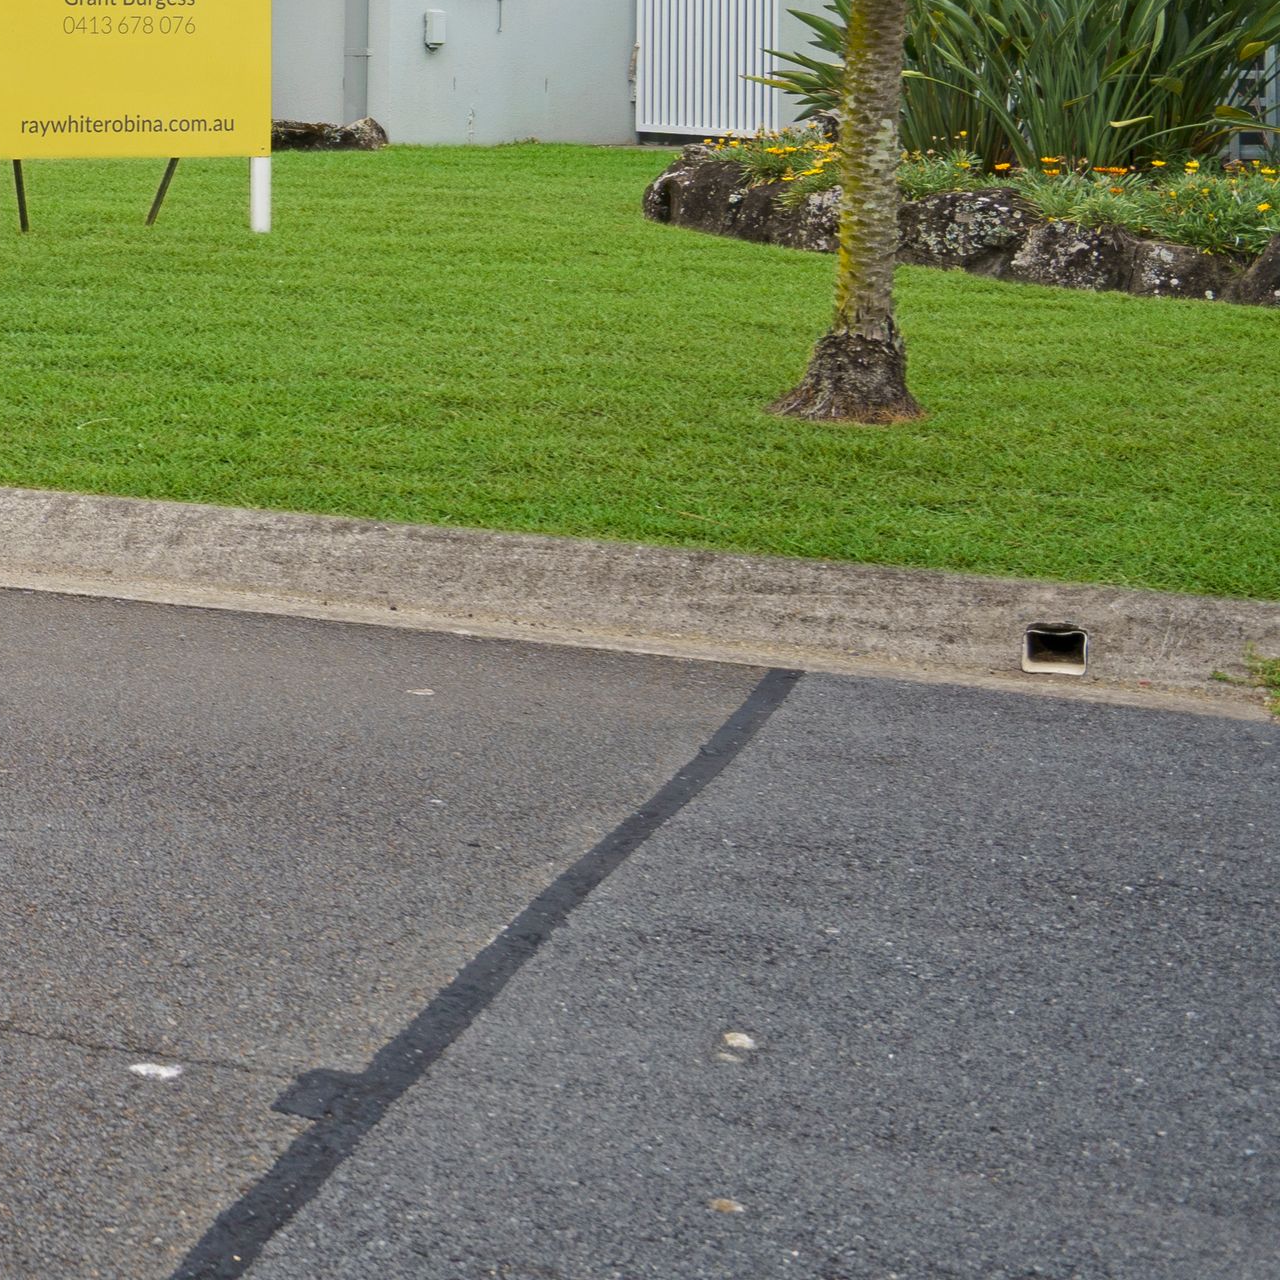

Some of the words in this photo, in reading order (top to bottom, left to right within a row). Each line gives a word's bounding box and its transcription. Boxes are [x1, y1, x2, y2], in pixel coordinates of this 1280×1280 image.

[62, 16, 113, 35] 0413
[117, 16, 154, 35] 678
[159, 16, 196, 35] 076
[21, 114, 235, 137] raywhiterobina.com.au
